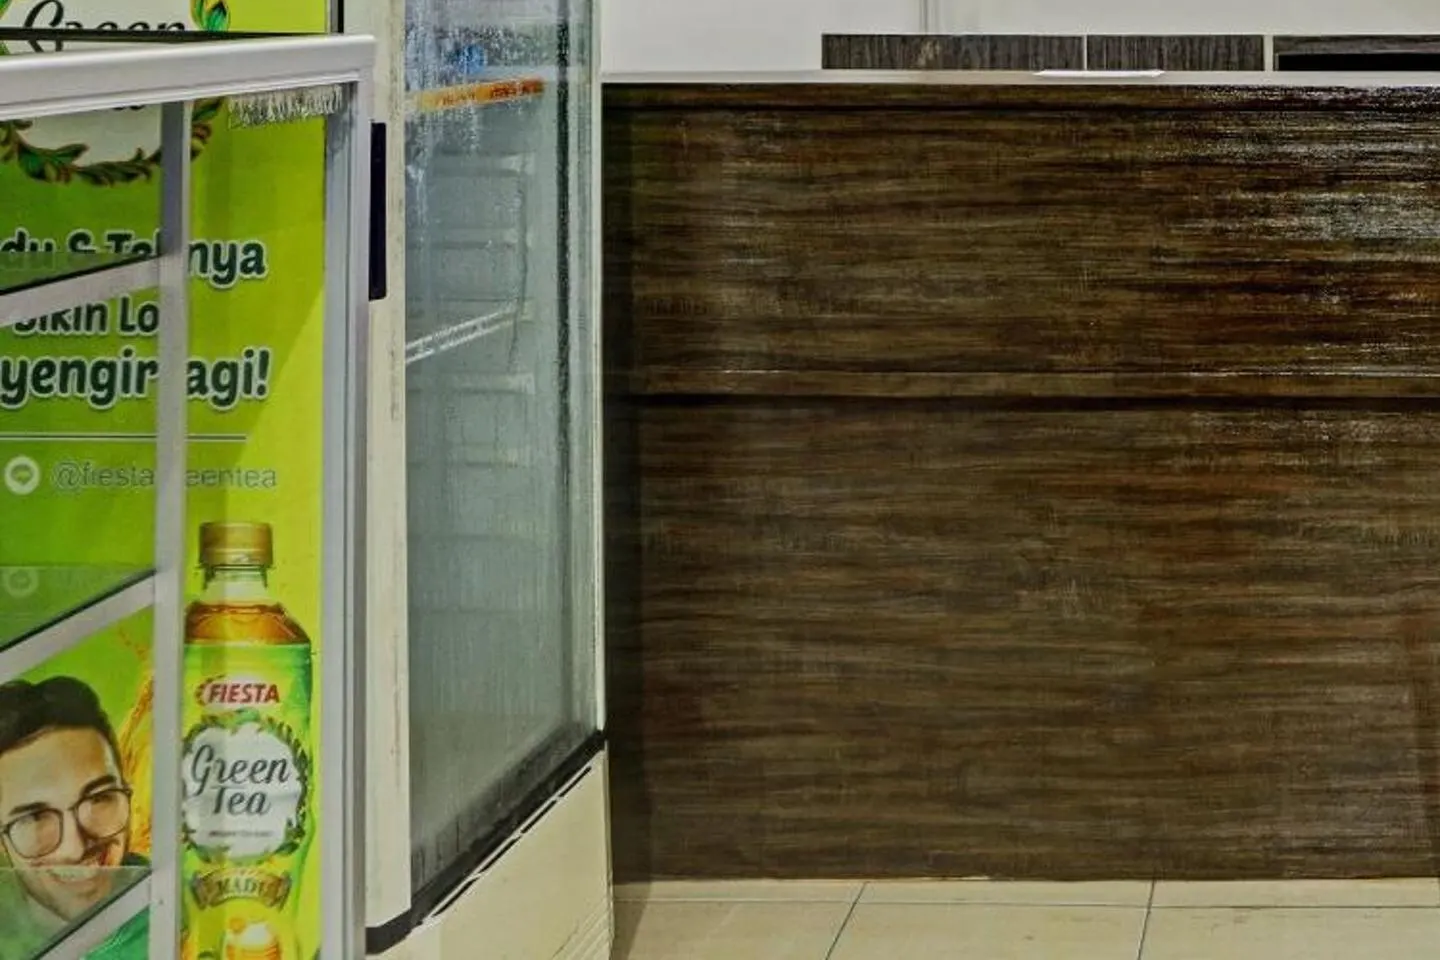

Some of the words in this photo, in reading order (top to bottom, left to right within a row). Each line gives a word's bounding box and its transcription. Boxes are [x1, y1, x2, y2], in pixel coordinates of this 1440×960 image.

[120, 297, 159, 332] Lo
[187, 349, 270, 407] agi!
[209, 683, 280, 703] FIESTA
[191, 744, 290, 796] Green
[211, 785, 271, 816] Tea
